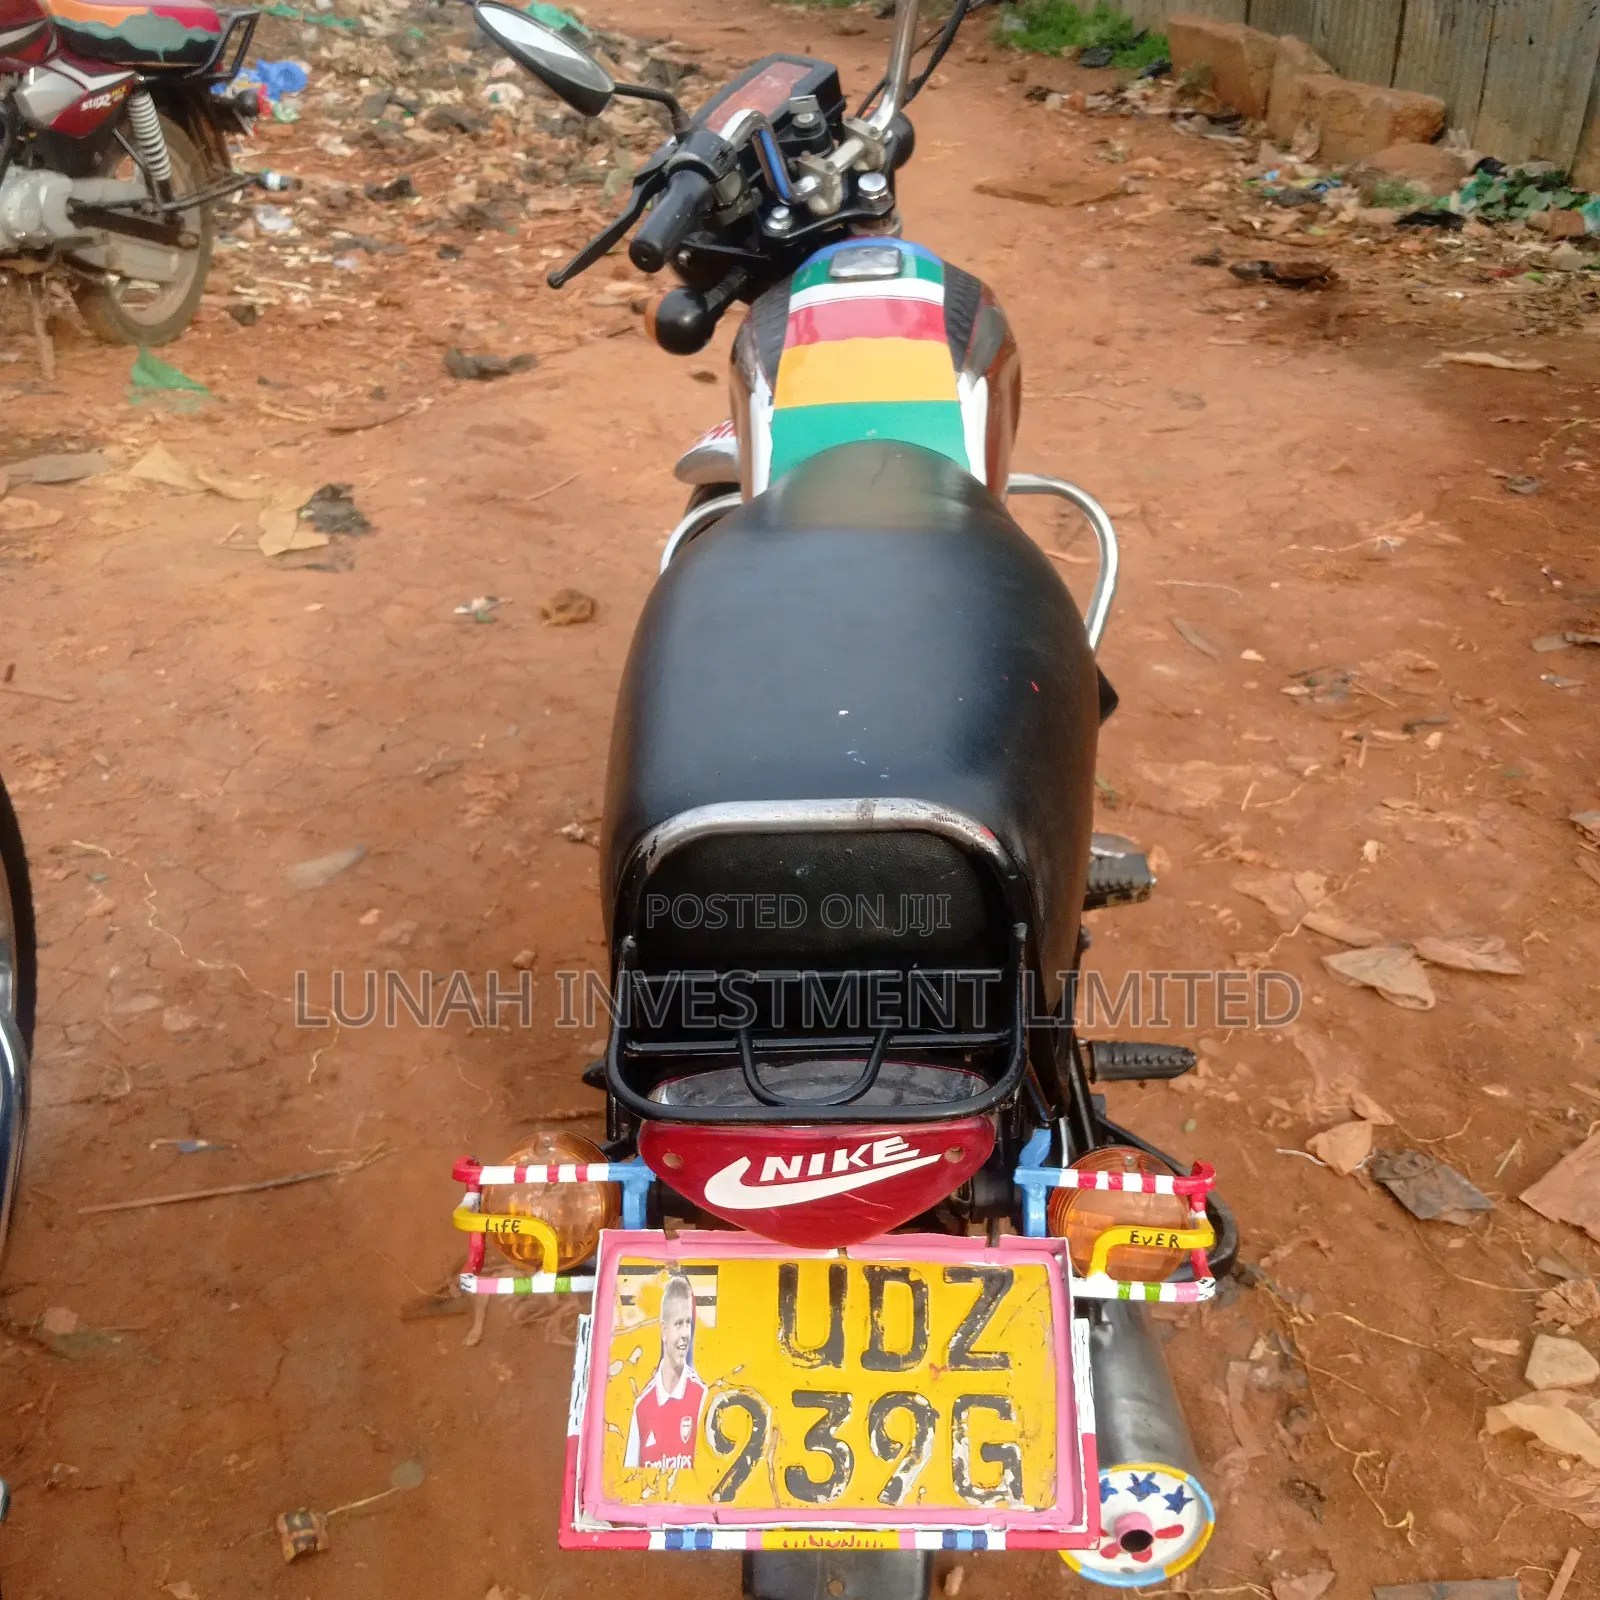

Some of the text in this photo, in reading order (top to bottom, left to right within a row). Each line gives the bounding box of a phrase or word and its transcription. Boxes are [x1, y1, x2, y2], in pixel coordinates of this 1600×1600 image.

[759, 1136, 921, 1182] NIKE
[485, 1218, 522, 1234] LIFE
[1129, 1230, 1181, 1248] EVER
[777, 1262, 1014, 1372] UDZ
[704, 1388, 1026, 1507] 939G
